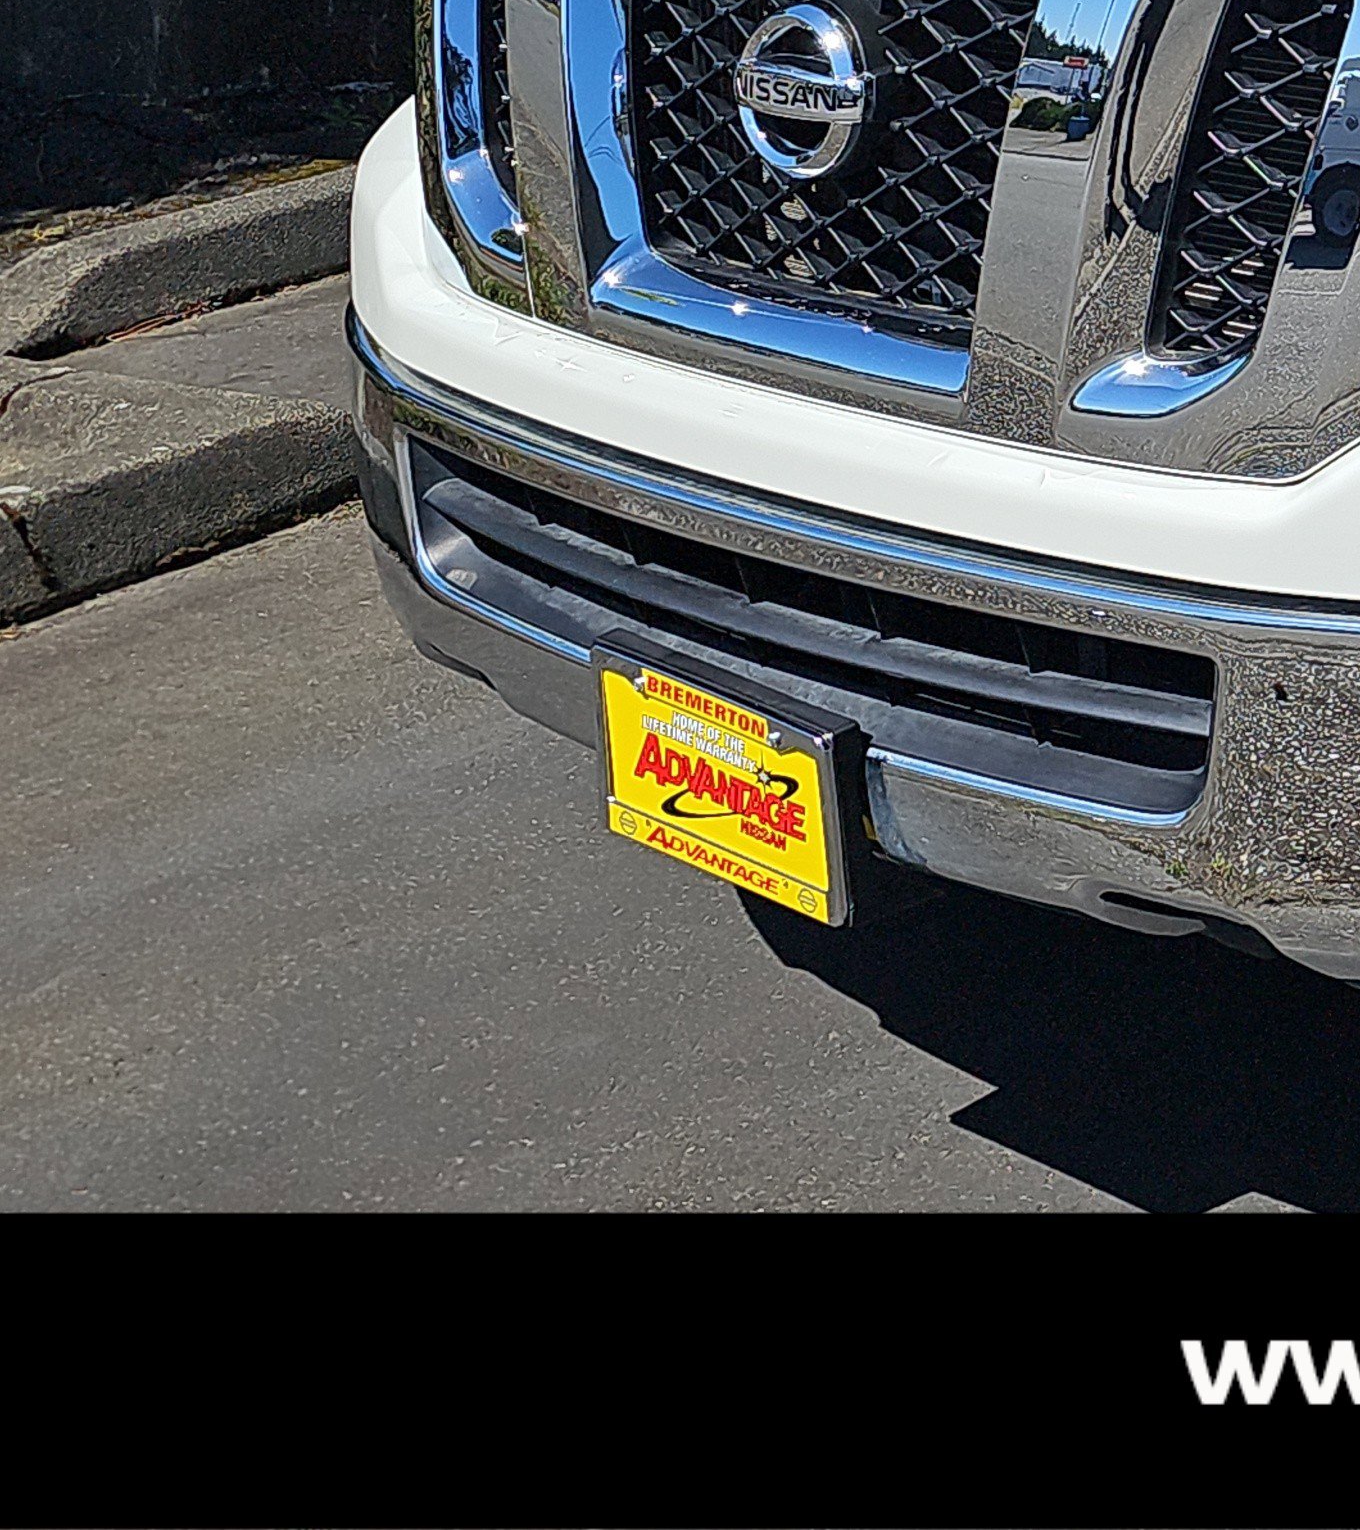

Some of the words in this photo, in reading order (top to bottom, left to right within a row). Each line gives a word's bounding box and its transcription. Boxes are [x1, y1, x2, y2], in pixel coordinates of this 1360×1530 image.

[737, 69, 838, 112] NISSAN
[647, 675, 765, 739] BREMERTON
[672, 710, 704, 734] HOME
[706, 725, 722, 742] OF
[724, 733, 745, 754] THE
[642, 714, 694, 747] LIFETIME
[696, 737, 757, 773] WARRANTY
[634, 731, 806, 842] ADVANTAGE
[646, 826, 780, 896] ADVANTAGE
